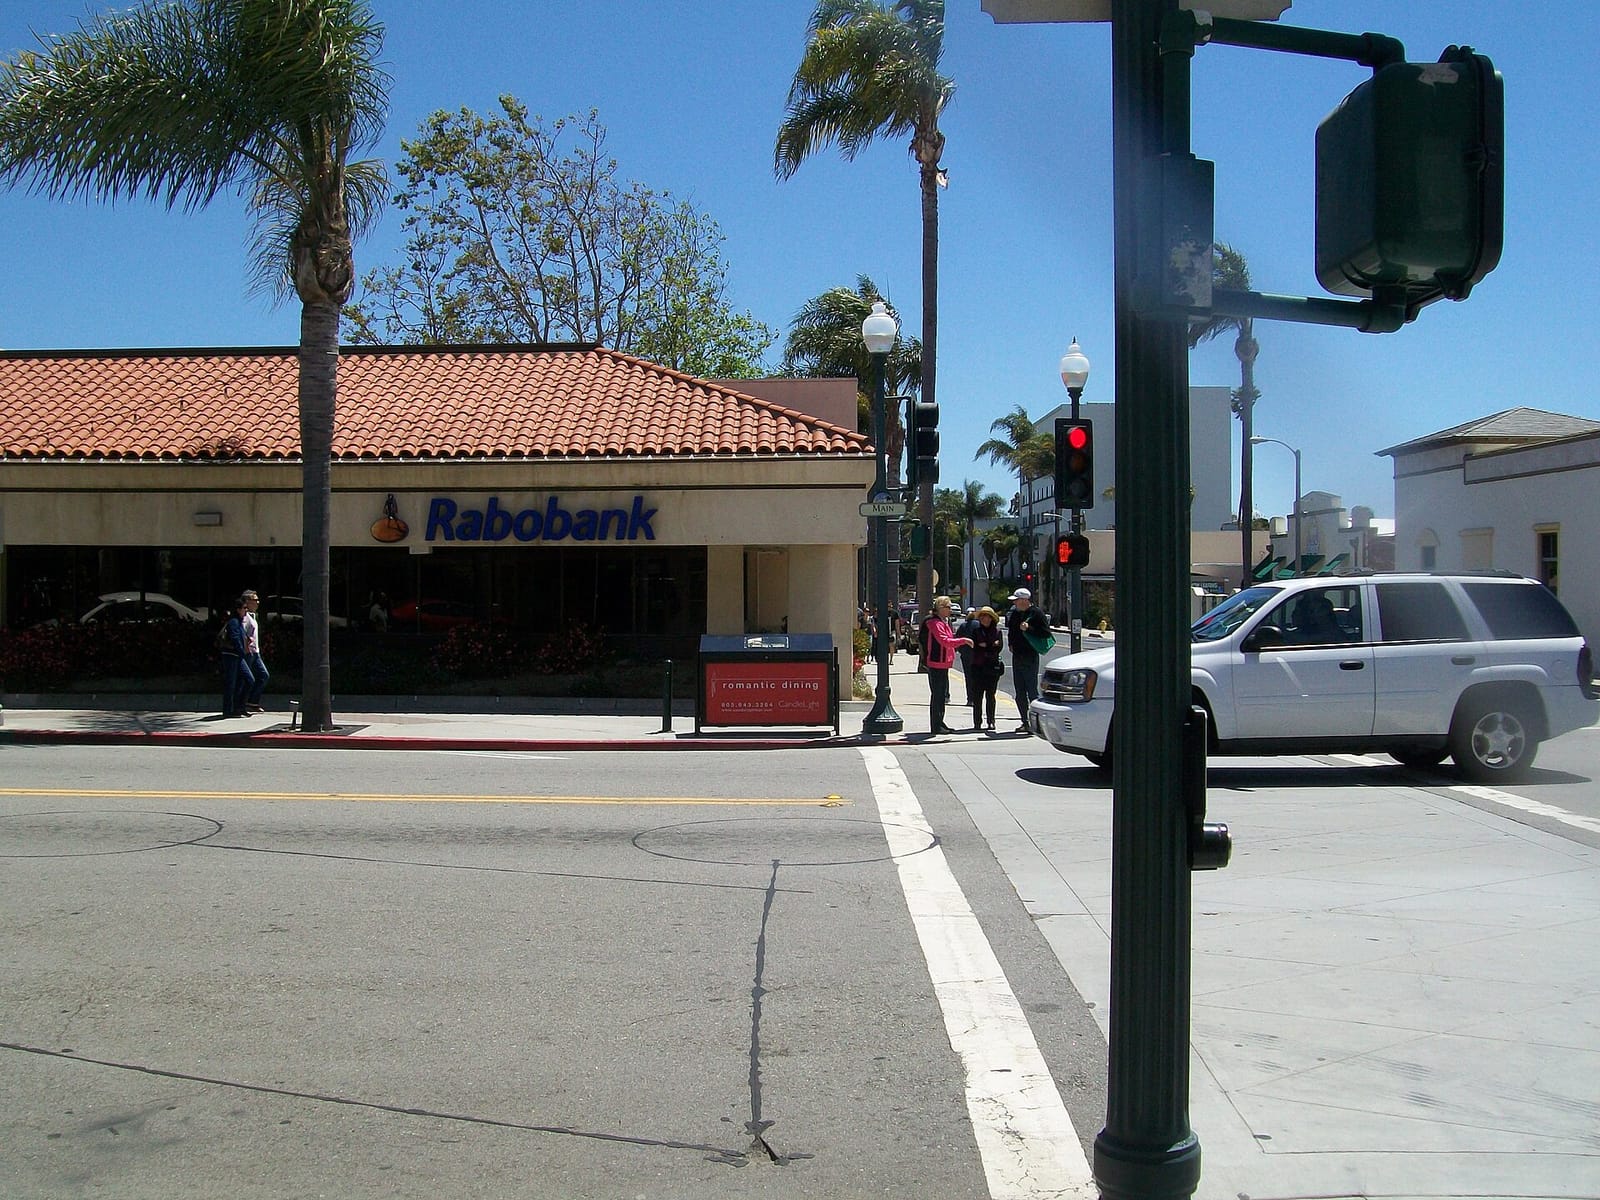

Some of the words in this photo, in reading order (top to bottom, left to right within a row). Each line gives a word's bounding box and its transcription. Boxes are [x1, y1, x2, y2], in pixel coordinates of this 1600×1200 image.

[425, 496, 658, 541] Rabobank
[722, 681, 776, 689] romantic
[781, 681, 819, 690] dining
